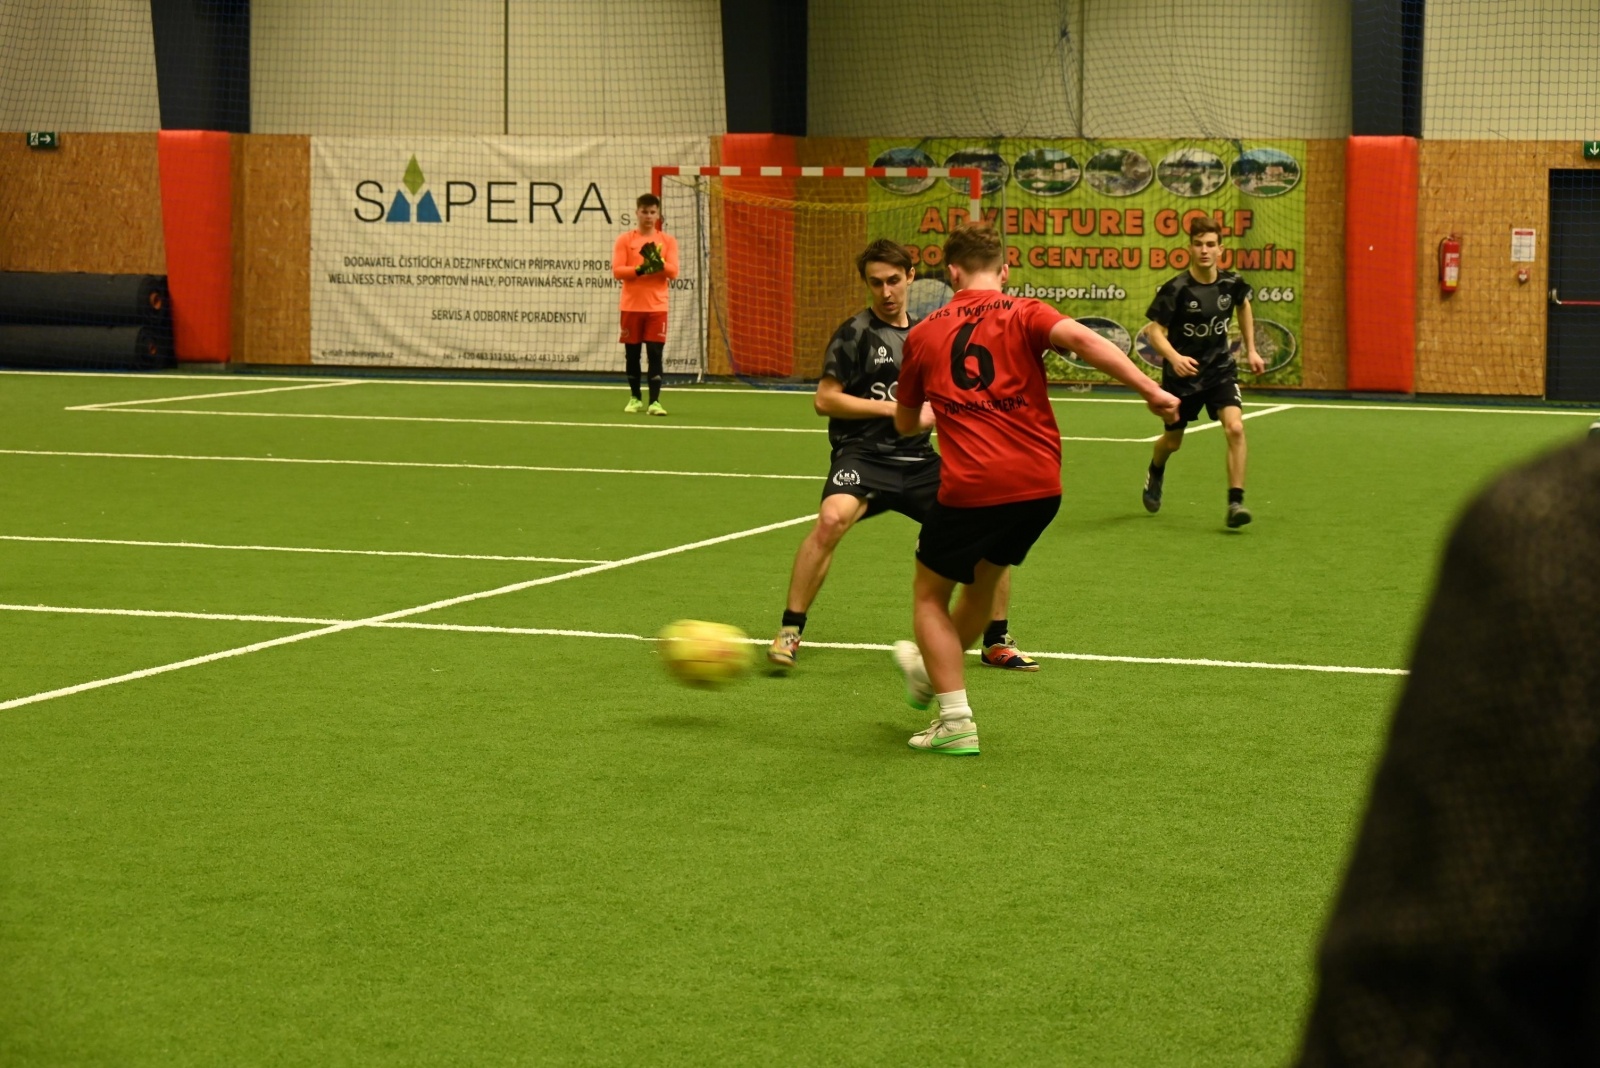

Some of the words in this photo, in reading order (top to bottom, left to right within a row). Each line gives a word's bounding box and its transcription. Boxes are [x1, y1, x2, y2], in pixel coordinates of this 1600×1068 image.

[343, 256, 397, 268] DODAVATEL
[398, 254, 443, 269] ČISTÍCÍCH
[444, 259, 451, 269] A
[452, 257, 526, 270] DEZINFEKČNÍCH
[528, 256, 581, 271] PŘÍPRAVKŮ
[582, 259, 603, 271] PRO
[903, 244, 1022, 269] BOR
[1028, 247, 1142, 271] CENTRU
[1150, 243, 1297, 271] BOUMÍN
[327, 273, 375, 285] WELLNESS
[376, 274, 414, 286] CENTRA,
[416, 273, 469, 286] SPORTOVNÍ
[471, 275, 497, 288] HALY,
[498, 274, 574, 288] POTRAVINÁŘSKÉ
[576, 277, 583, 288] A
[1257, 287, 1295, 302] 666
[431, 309, 463, 321] SERVIS
[464, 311, 471, 321] A
[473, 309, 519, 322] ODBORNÉ
[520, 310, 588, 324] PORADENSTVÍ
[928, 308, 951, 321] LKS
[950, 317, 996, 392] 6
